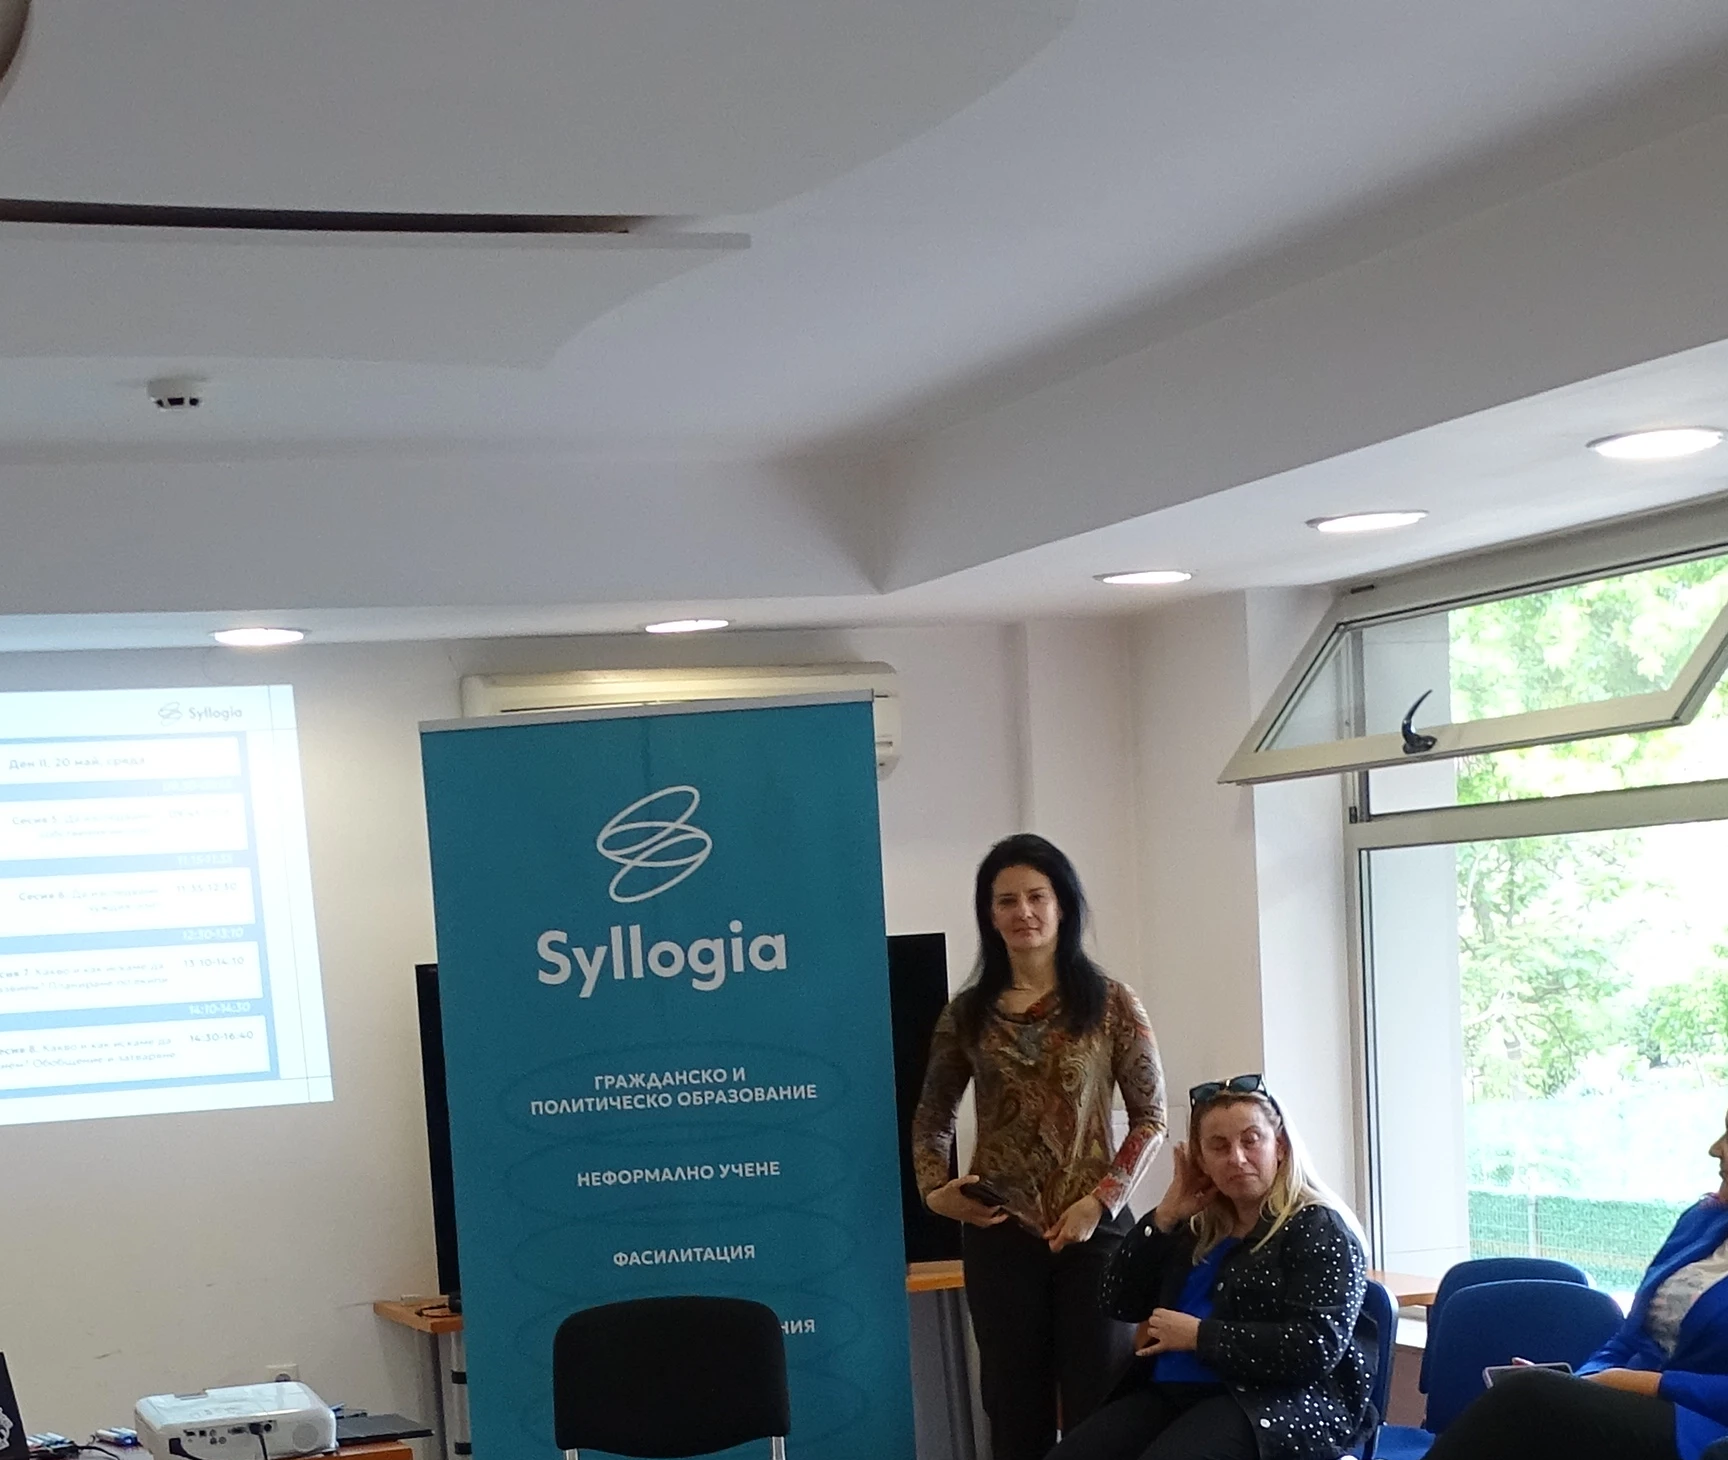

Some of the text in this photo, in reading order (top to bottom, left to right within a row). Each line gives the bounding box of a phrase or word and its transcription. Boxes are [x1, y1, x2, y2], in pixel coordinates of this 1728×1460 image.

[188, 705, 243, 722] Syllogia
[8, 758, 35, 771] Ден
[536, 919, 788, 998] Syllogia
[593, 1066, 746, 1092] ГРАЖДАНСКО И
[530, 1083, 818, 1117] ПОЛИТИЧЕСКО ОБРАЗОВАНИЕ
[576, 1159, 781, 1188] НЕФОРМАЛНО УЧЕНЕ
[612, 1244, 756, 1268] ФАСИЛИТАЦИЯ
